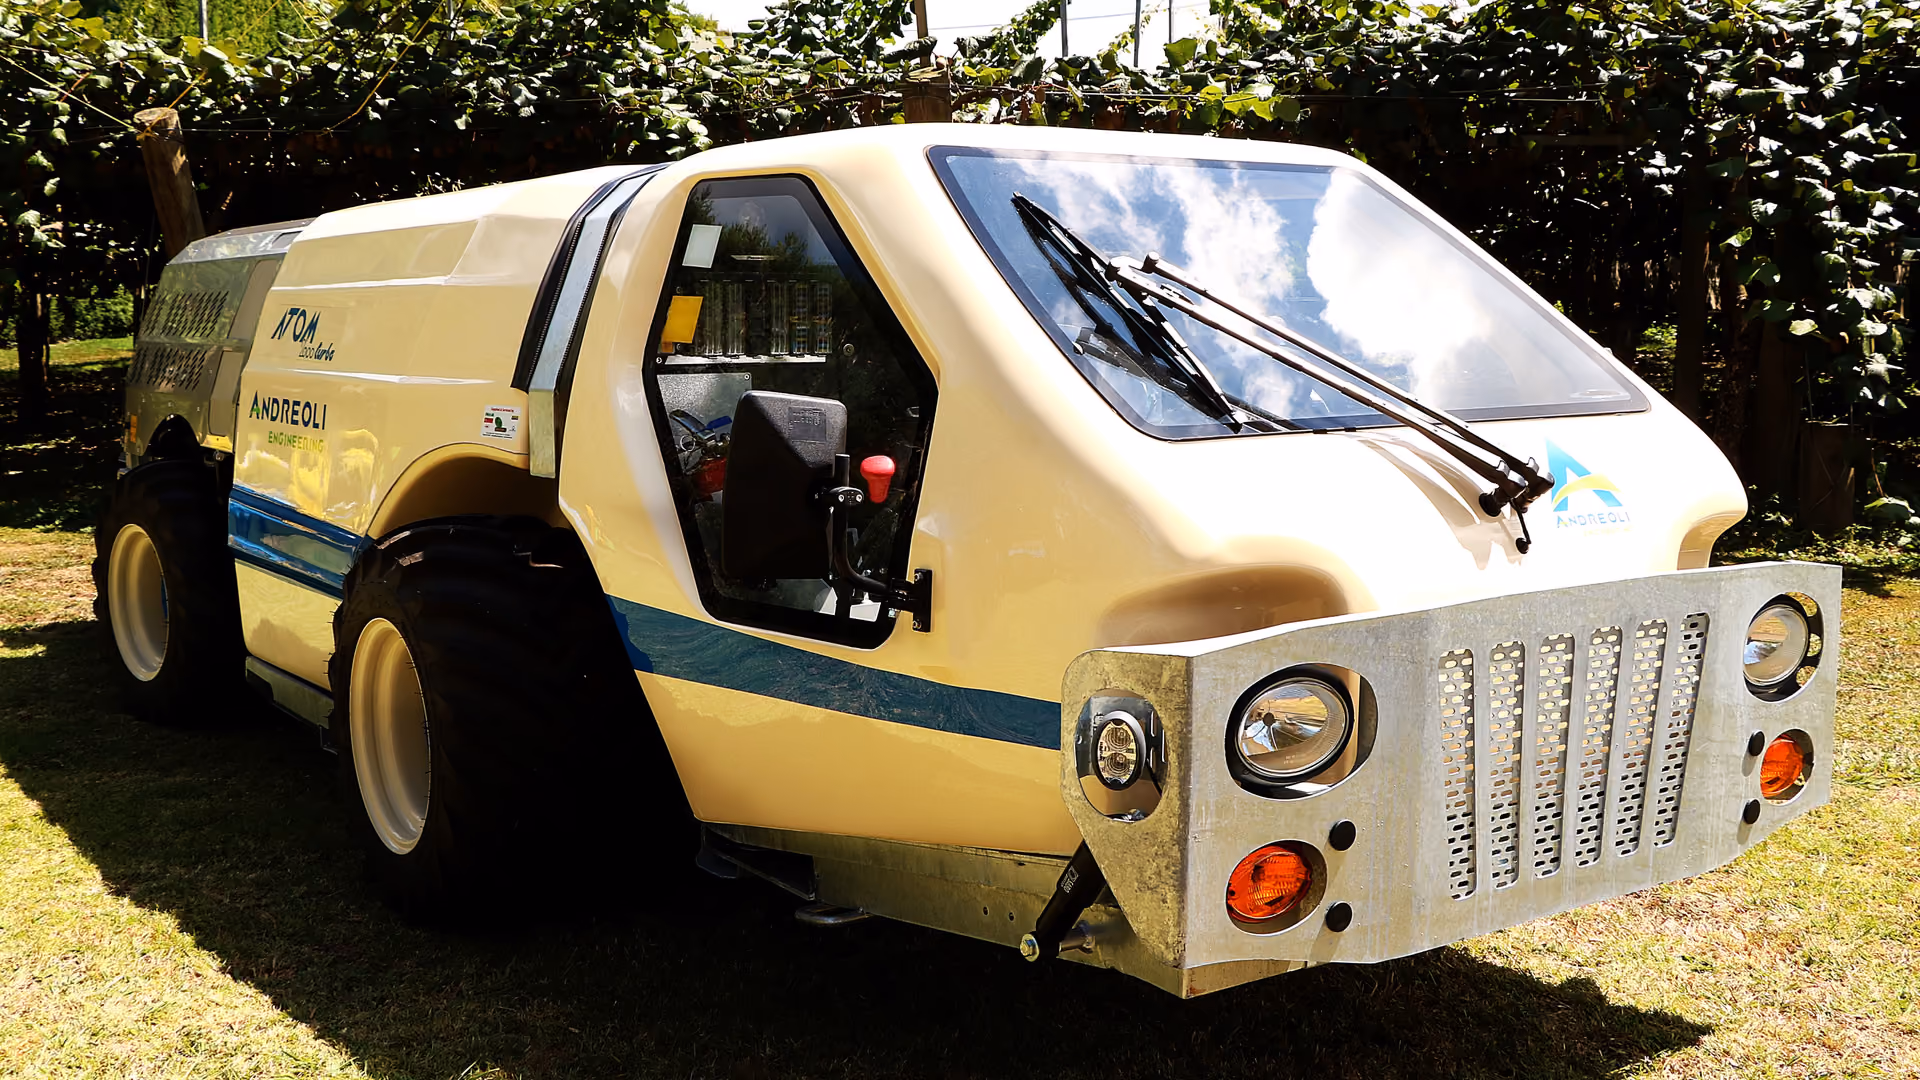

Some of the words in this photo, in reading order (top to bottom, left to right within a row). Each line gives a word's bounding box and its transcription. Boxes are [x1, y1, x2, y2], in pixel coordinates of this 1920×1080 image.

[270, 307, 321, 343] ATOM
[248, 390, 327, 430] ANDREOLI
[268, 431, 324, 453] ENGINEERING
[1557, 511, 1630, 528] ANDREOLI
